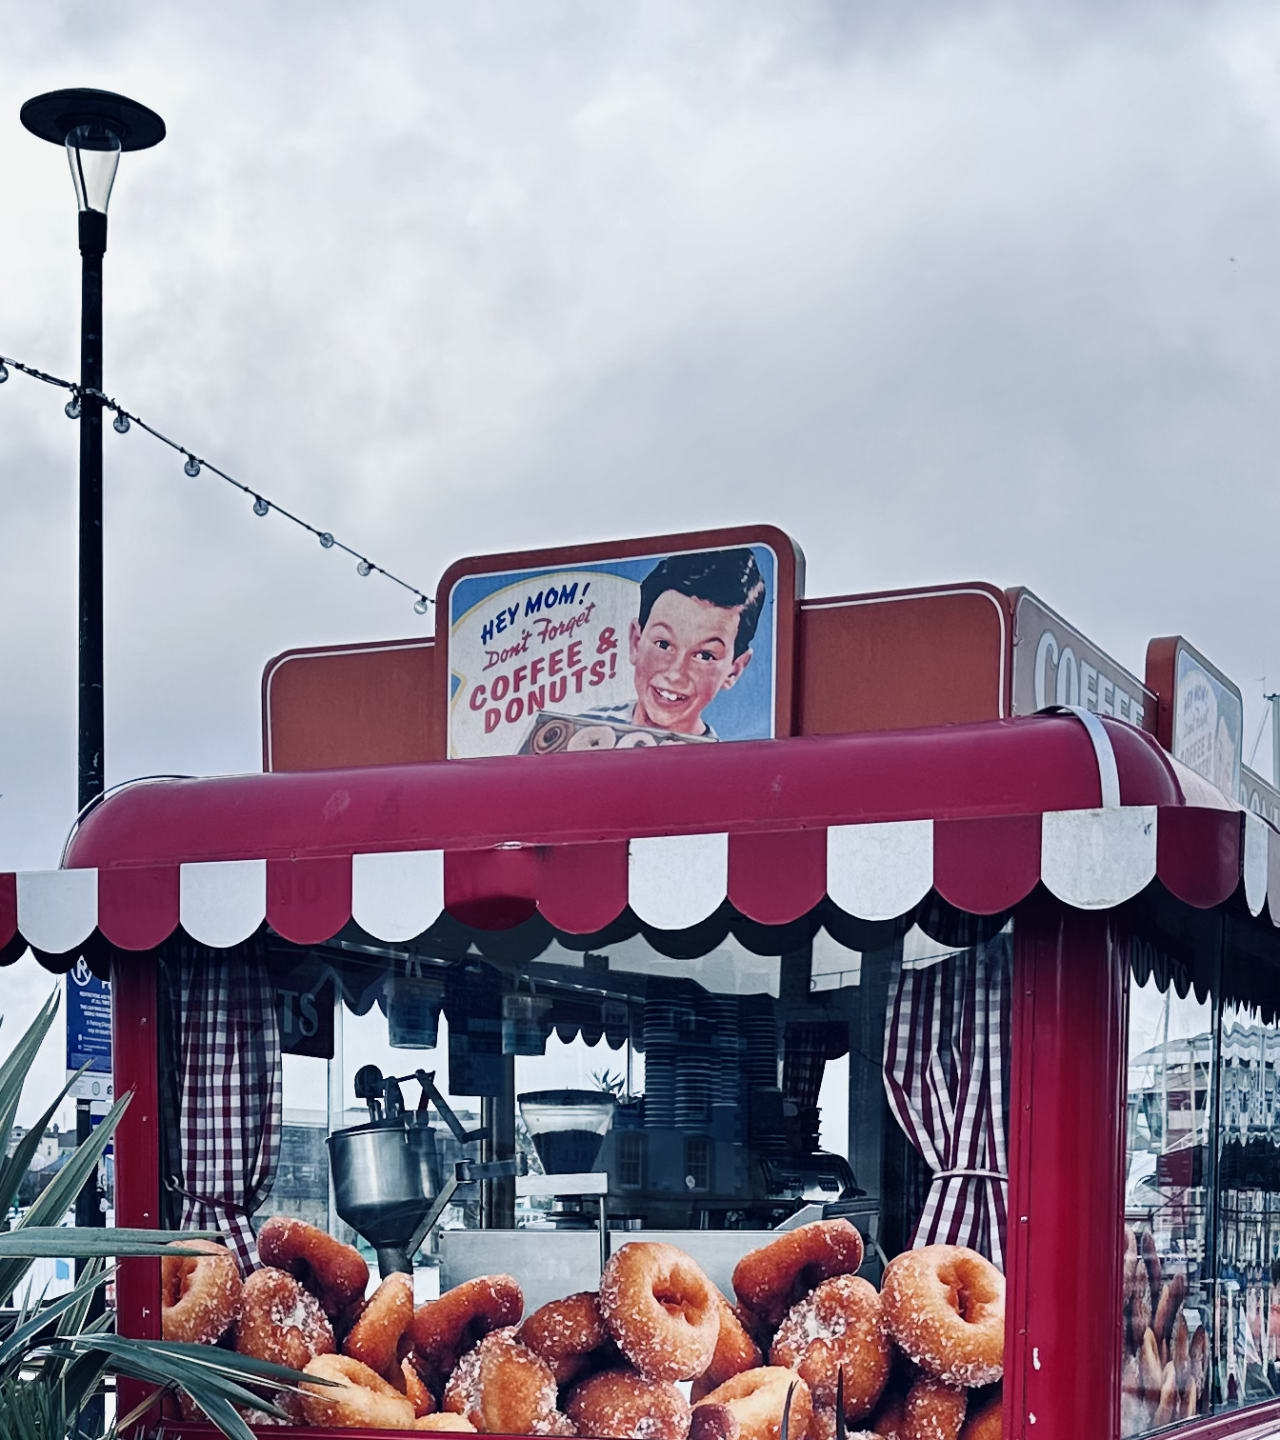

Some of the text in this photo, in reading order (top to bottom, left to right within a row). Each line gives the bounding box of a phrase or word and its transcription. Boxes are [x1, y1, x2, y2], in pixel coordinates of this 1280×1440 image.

[481, 582, 591, 645] HEY MOM!
[482, 602, 596, 671] Don't Forget
[469, 627, 618, 711] COFFEE &
[485, 653, 618, 733] DONUTS!
[1034, 630, 1145, 728] COFFEE
